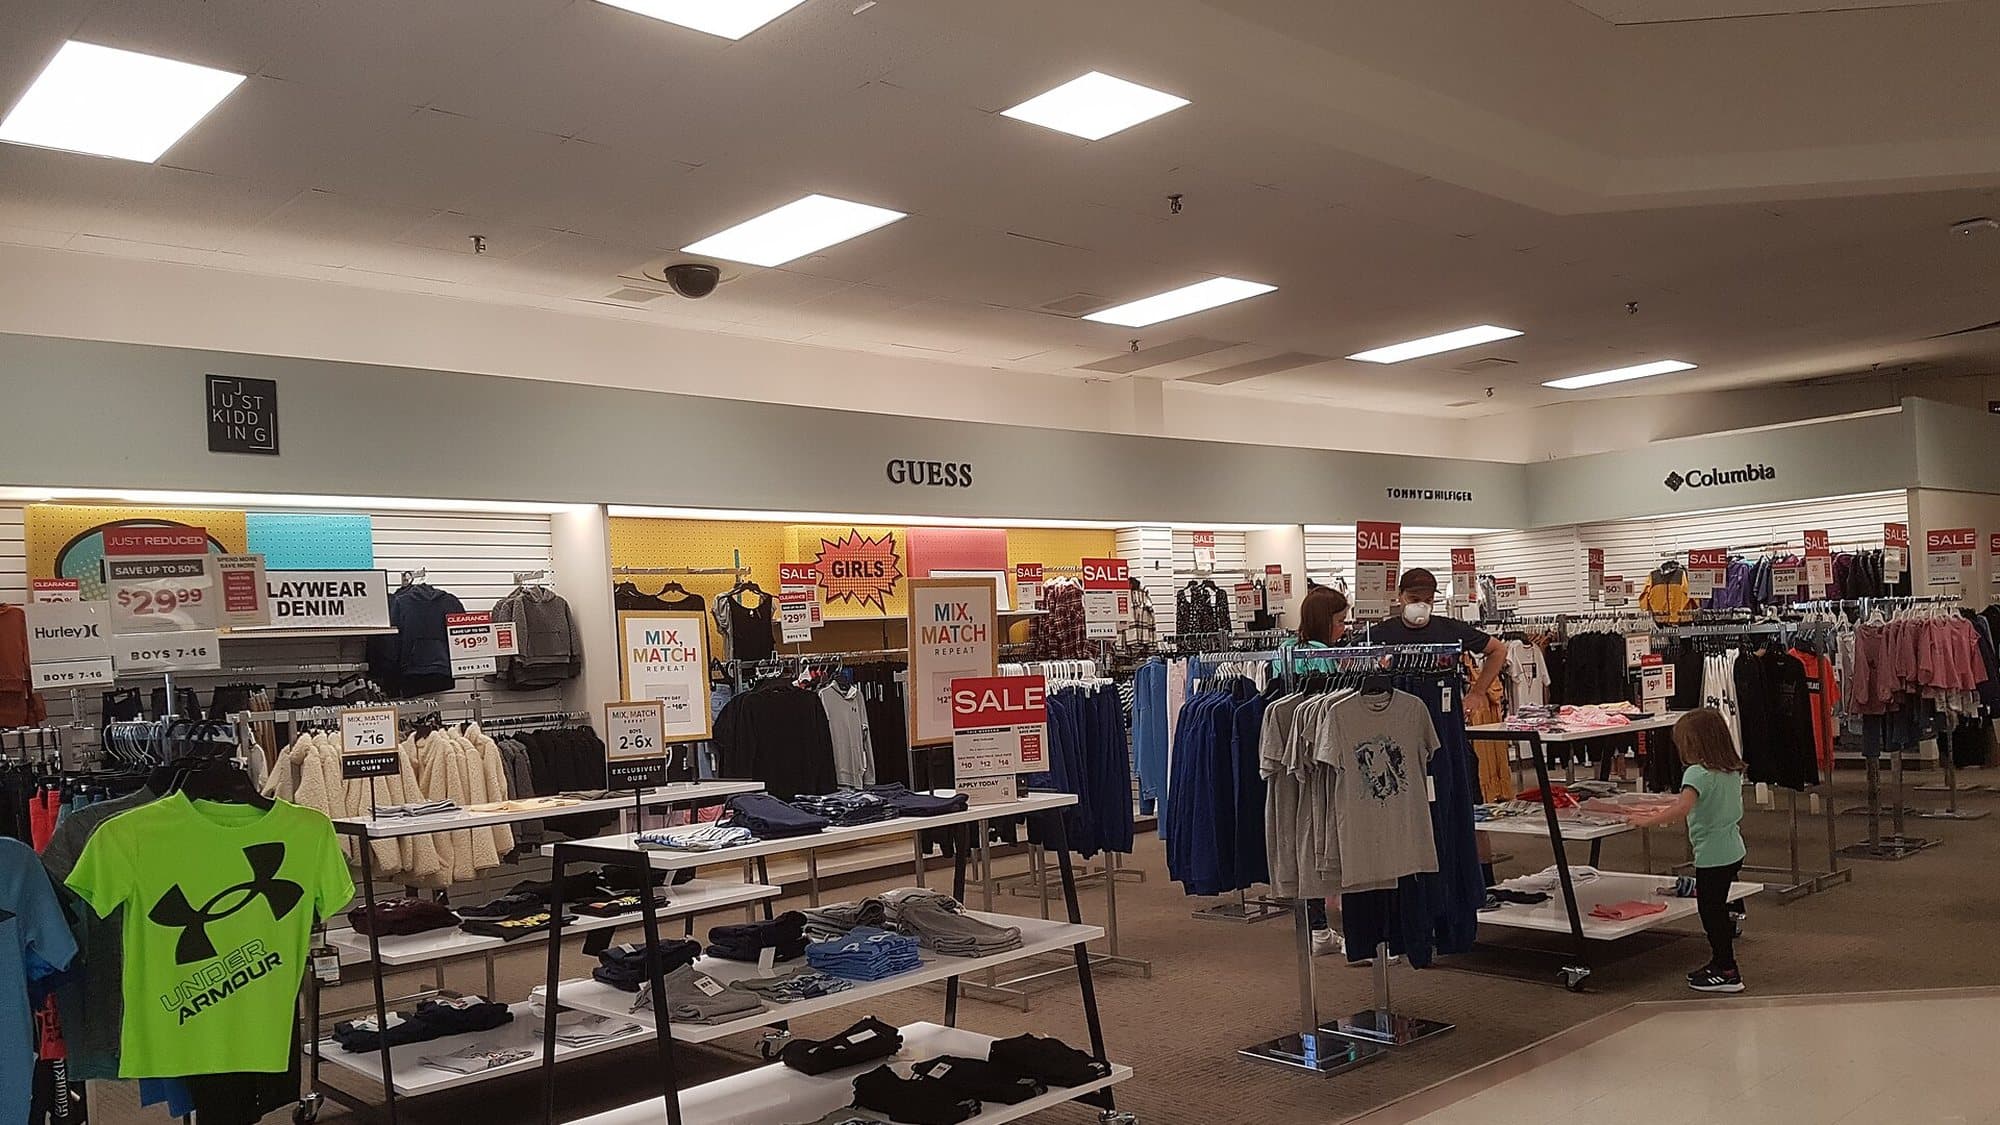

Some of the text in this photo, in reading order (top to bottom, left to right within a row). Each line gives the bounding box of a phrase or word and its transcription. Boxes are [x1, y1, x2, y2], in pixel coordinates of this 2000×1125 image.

[886, 459, 973, 488] GUESS
[1685, 464, 1776, 488] Columbia
[1386, 487, 1473, 501] TOMMY HILFIGER
[1193, 535, 1214, 544] SALE
[1357, 531, 1400, 550] SALE
[1885, 528, 1907, 540] SALE
[1928, 533, 1975, 546] SALE
[109, 536, 204, 546] JUST REDUCED
[1805, 537, 1828, 550] SALE
[1452, 554, 1475, 565] SALE
[1689, 553, 1726, 564] SALE
[115, 564, 199, 575] SAVE UP TO 50%
[781, 568, 816, 579] SALE
[832, 560, 884, 578] GIRLS
[1017, 567, 1042, 577] SALE
[1084, 566, 1128, 581] SALE
[266, 581, 367, 598] LAYWEAR
[277, 600, 345, 616] DENIM
[935, 603, 973, 623] MIX,
[447, 615, 489, 623] CLEARANCE
[35, 624, 82, 640] Hurley
[645, 630, 683, 647] MIX,
[921, 624, 986, 645] MATCH
[131, 647, 207, 660] BOYS 7-16
[633, 647, 697, 663] MATCH
[935, 647, 975, 656] REPEAT
[43, 671, 102, 681] BOYS 7-16
[954, 687, 1045, 714] SALE
[630, 709, 657, 718] MATCH
[354, 733, 385, 746] 7-16
[347, 757, 394, 766] EXCLUSIVELY
[612, 765, 661, 775] EXCLUSIVELY
[627, 774, 648, 782] OURS
[978, 779, 999, 787] TODAY
[160, 938, 267, 1012] UNDER
[179, 951, 283, 1026] ARMOUR
